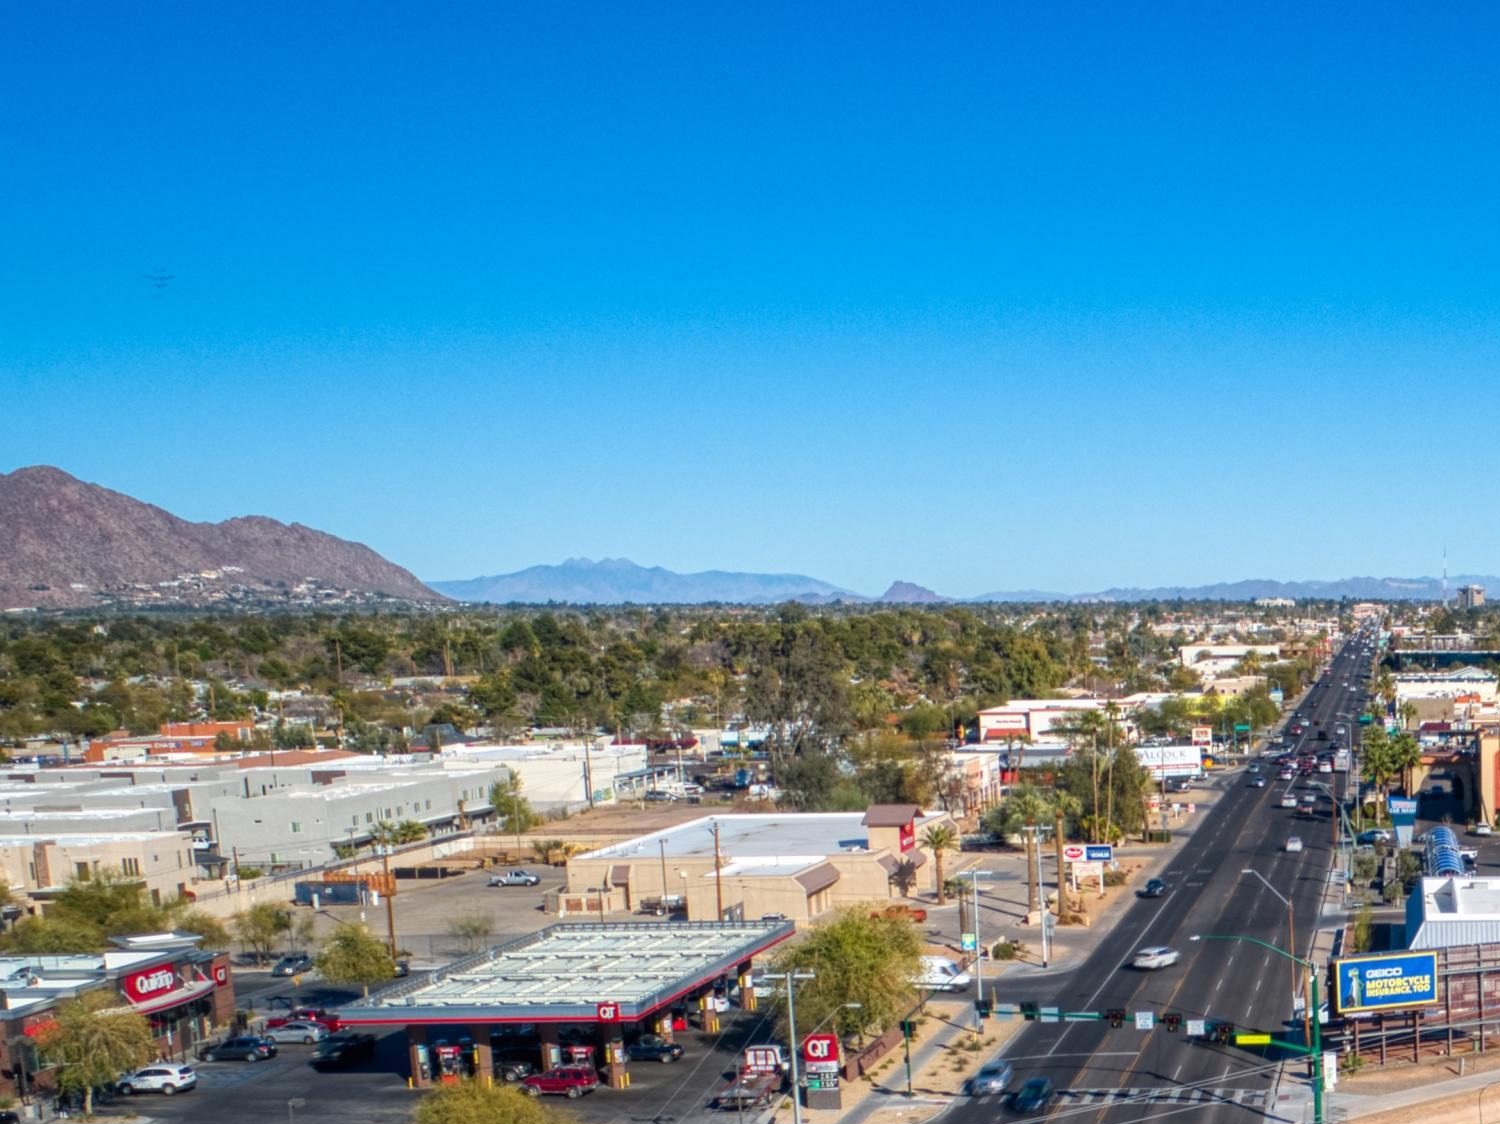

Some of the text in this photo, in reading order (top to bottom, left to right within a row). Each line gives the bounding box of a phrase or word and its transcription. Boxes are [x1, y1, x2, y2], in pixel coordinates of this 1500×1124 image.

[1366, 967, 1402, 979] GEICO
[136, 970, 173, 995] QuikTrip
[1366, 975, 1431, 990] MOTORCYCLE
[1412, 983, 1431, 992] TOO
[600, 1006, 616, 1020] QT
[807, 1039, 831, 1058] QT
